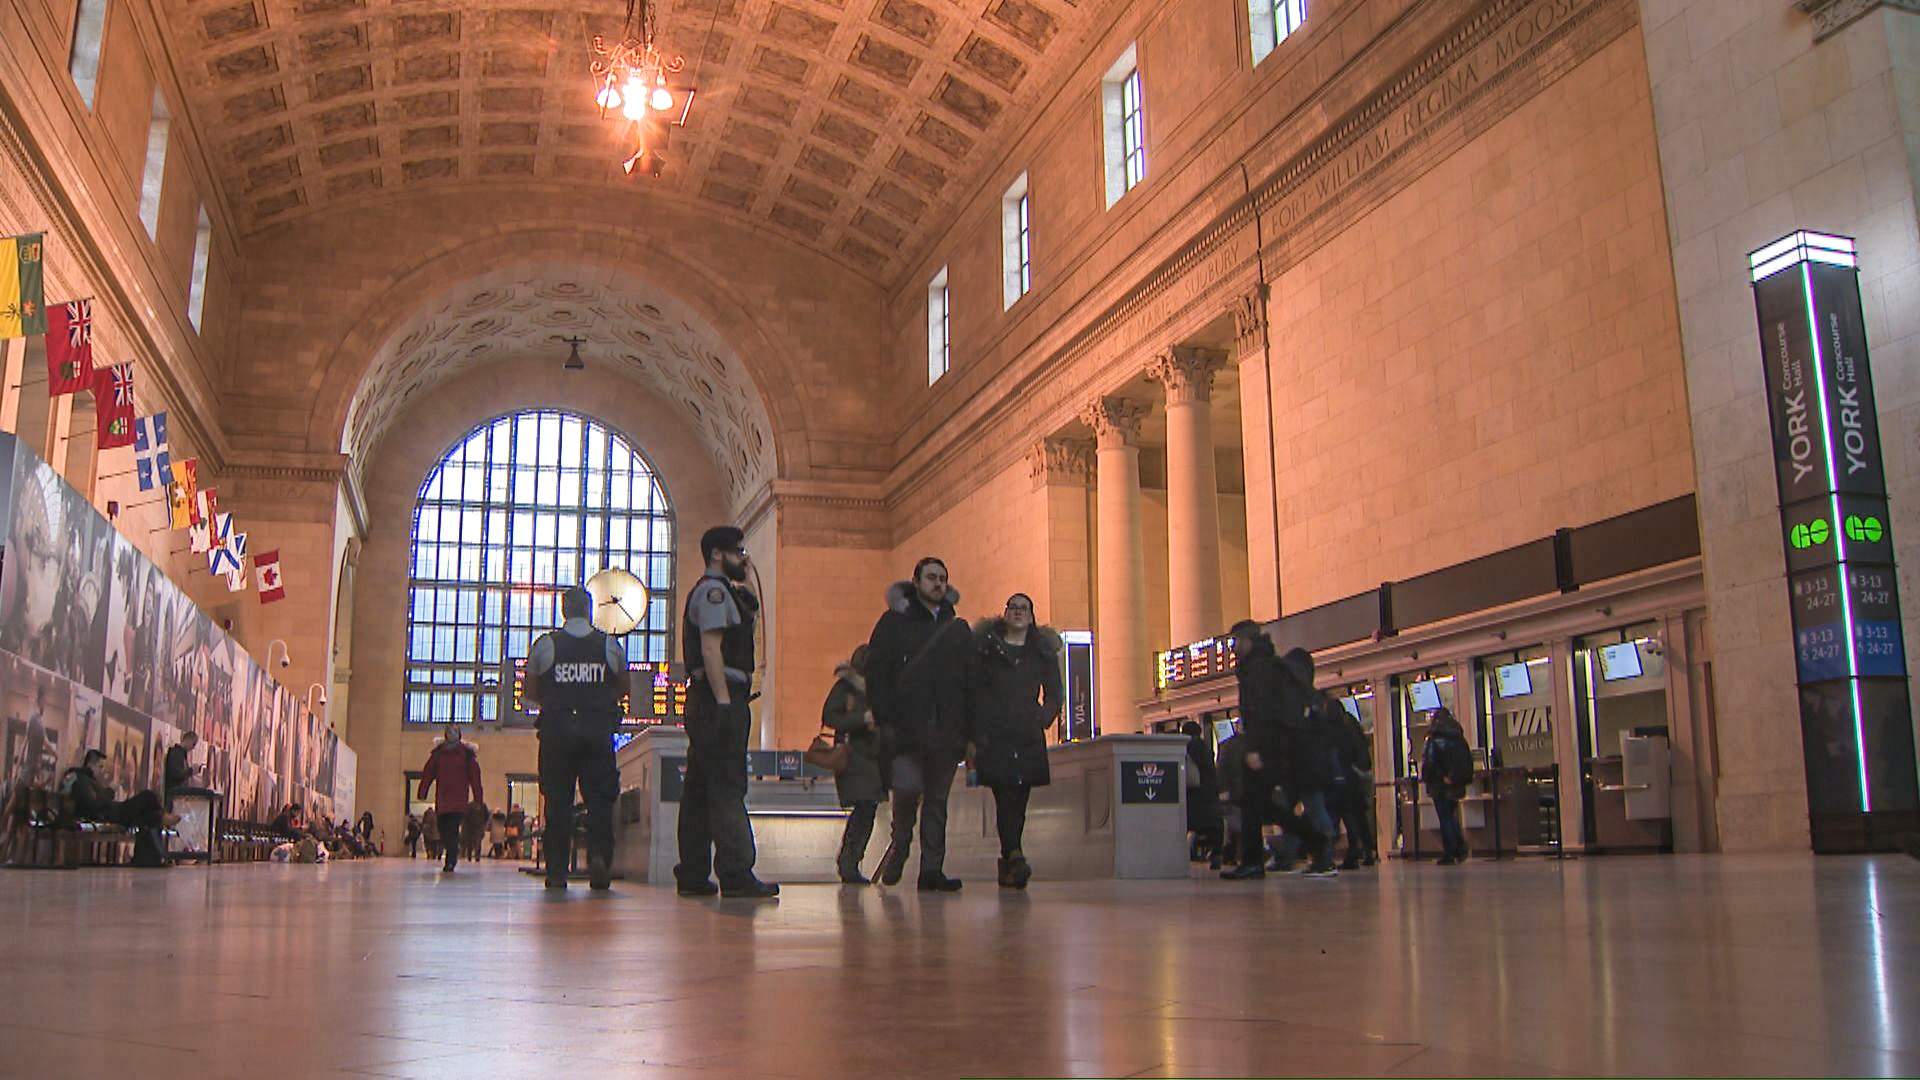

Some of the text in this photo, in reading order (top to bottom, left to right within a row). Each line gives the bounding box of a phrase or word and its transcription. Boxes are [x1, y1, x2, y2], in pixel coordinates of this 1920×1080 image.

[1185, 240, 1238, 299] SUDBURY
[1272, 191, 1310, 235] FORT
[1315, 127, 1391, 199] WILLIAM
[1403, 63, 1479, 135] REGINA
[1778, 322, 1792, 391] Concourse
[1830, 313, 1845, 381] Concourse
[1791, 359, 1802, 387] Hall
[1844, 356, 1855, 383] Hall
[1785, 389, 1814, 485] YORK
[1838, 385, 1867, 475] YORK
[1804, 577, 1829, 595] 3-13
[1859, 575, 1882, 589] 3-13
[1806, 592, 1836, 611] 24-27
[1861, 591, 1889, 605] 24-27
[1809, 628, 1834, 645] 3-13
[1865, 626, 1889, 639] 3-13
[1812, 645, 1840, 661] 24-27
[1867, 643, 1894, 655] 24-27
[554, 662, 607, 683] SECURITY
[1507, 707, 1550, 737] VIA
